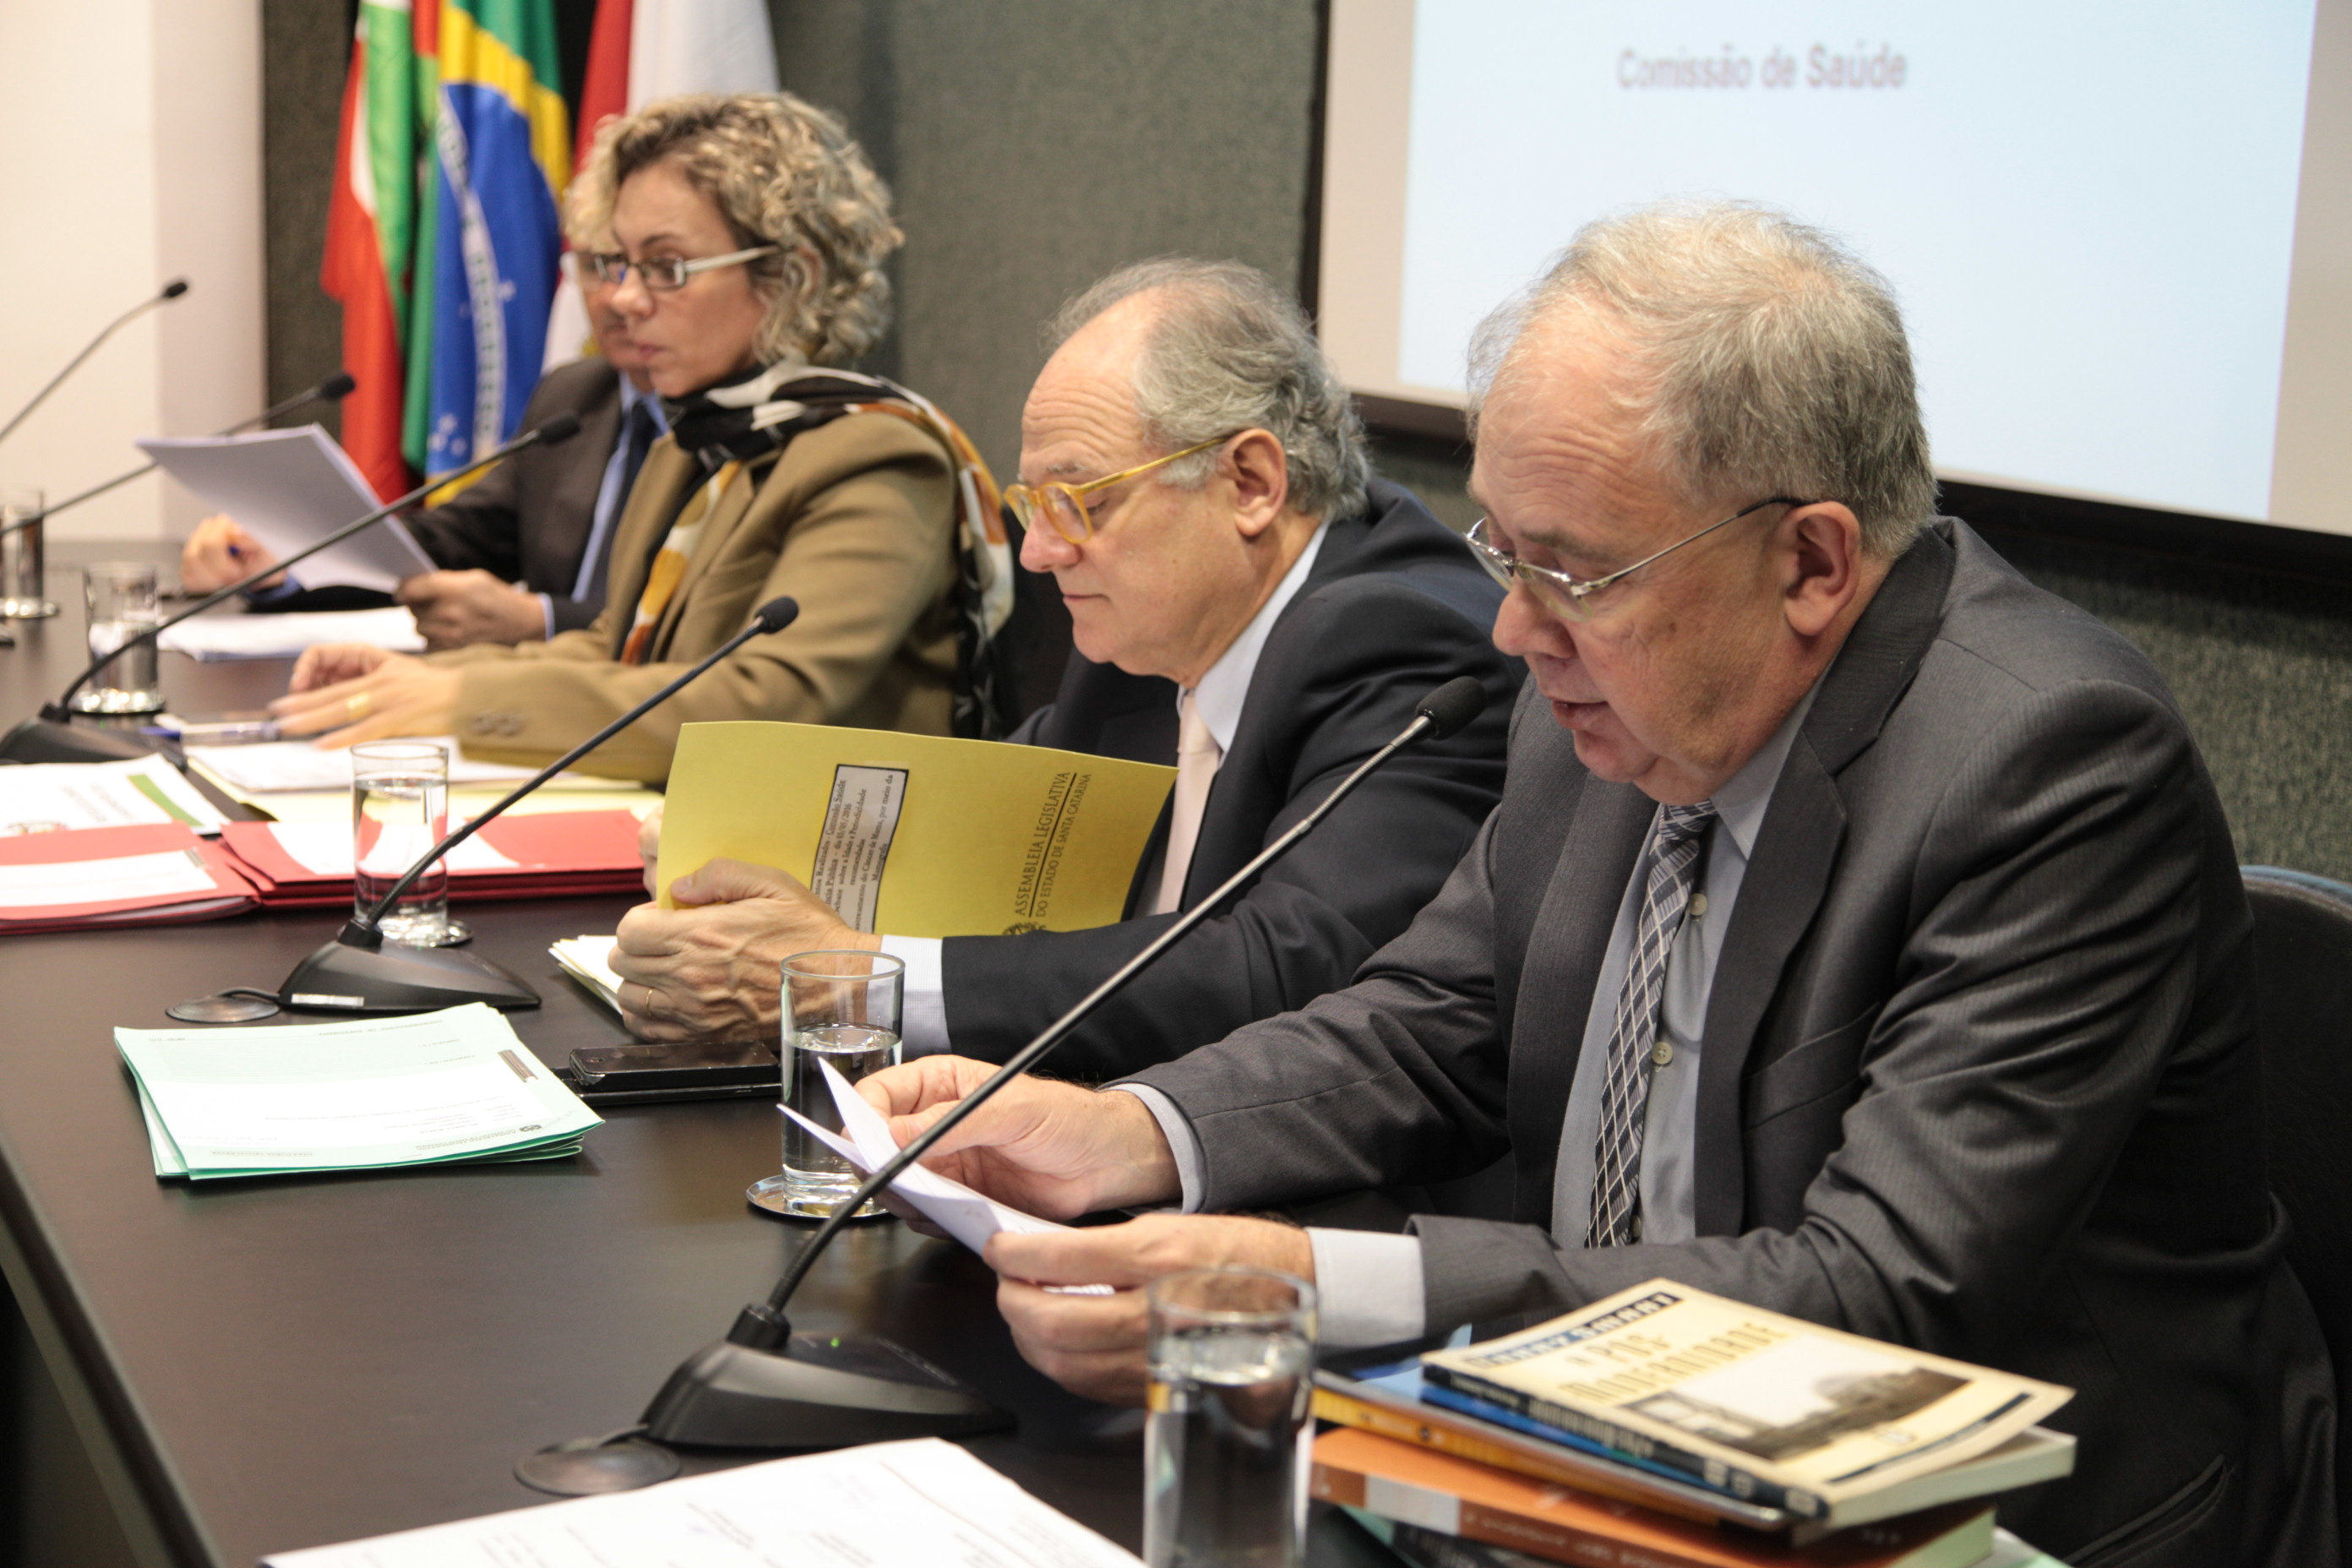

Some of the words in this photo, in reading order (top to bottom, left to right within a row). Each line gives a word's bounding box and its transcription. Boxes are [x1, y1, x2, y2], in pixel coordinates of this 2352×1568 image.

[1617, 42, 1752, 88] Comissão
[1762, 46, 1796, 87] de
[1807, 39, 1906, 87] Saúde
[835, 780, 846, 803] Saúde
[1067, 773, 1092, 814] CATARINA
[1015, 841, 1044, 916] ASSEMBLEIA
[1034, 771, 1070, 839] LEGISLATIVA
[1057, 817, 1075, 843] SANTA
[1052, 845, 1064, 858] DE
[1041, 860, 1059, 897] ESTADO
[1036, 901, 1048, 917] DO
